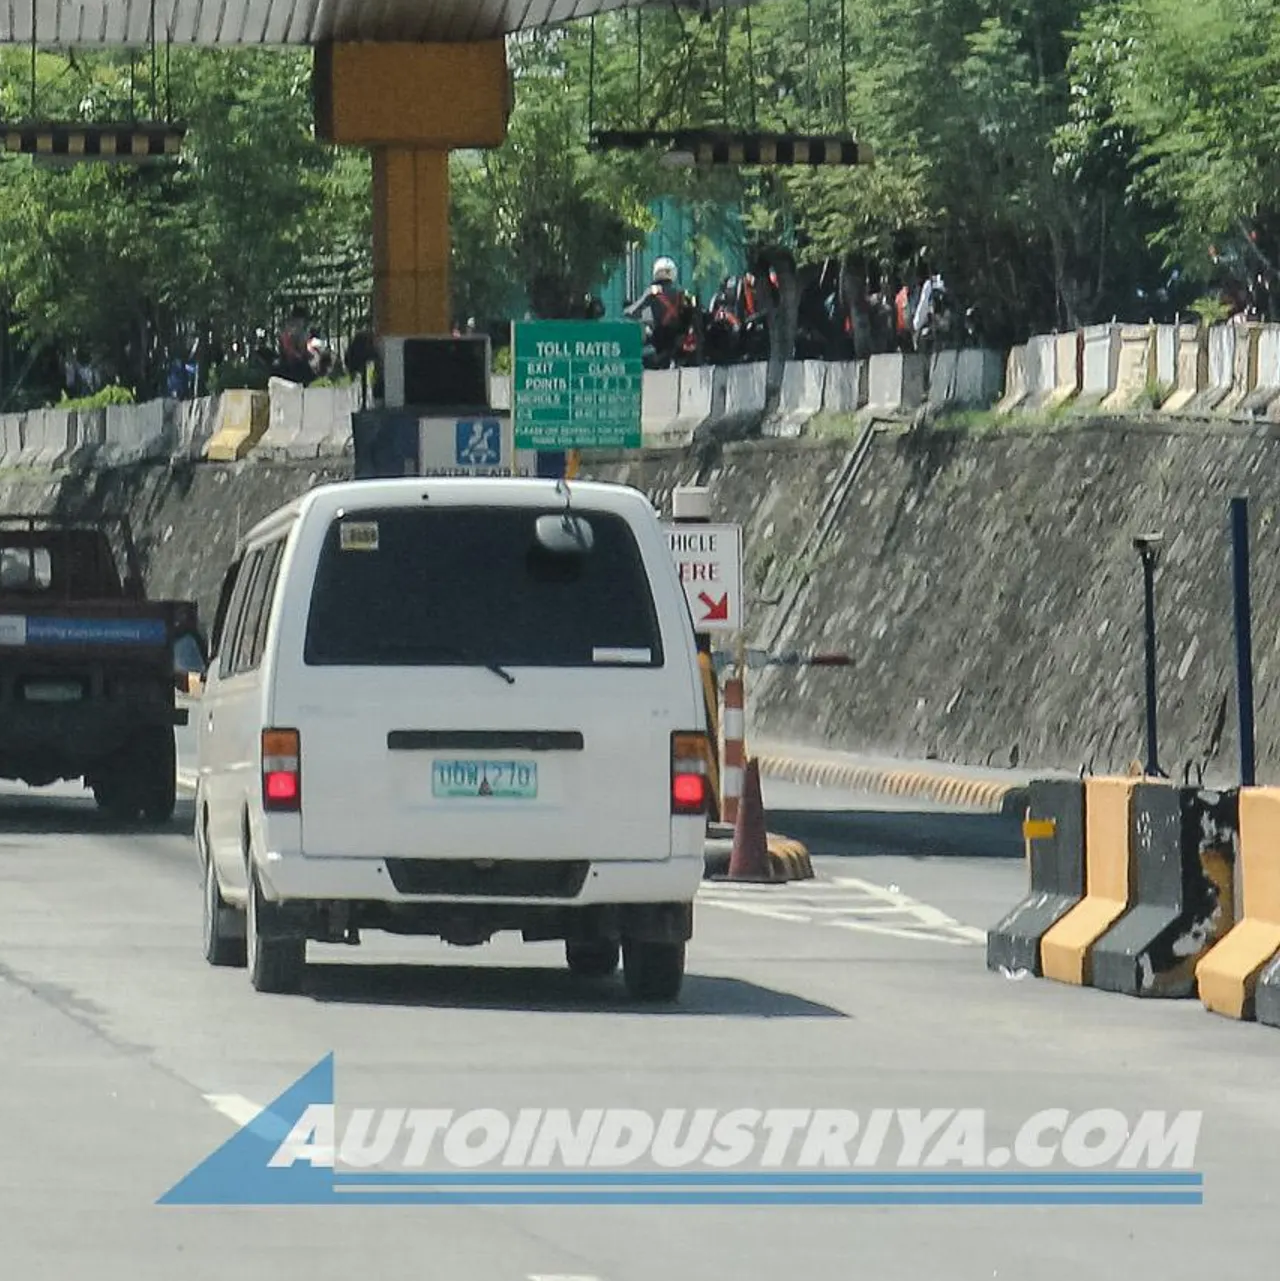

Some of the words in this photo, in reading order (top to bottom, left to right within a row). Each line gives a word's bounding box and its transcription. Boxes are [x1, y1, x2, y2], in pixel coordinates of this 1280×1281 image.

[536, 341, 572, 357] TOLL
[575, 341, 622, 358] RATES
[670, 534, 717, 552] HICLE
[679, 562, 720, 582] ERE
